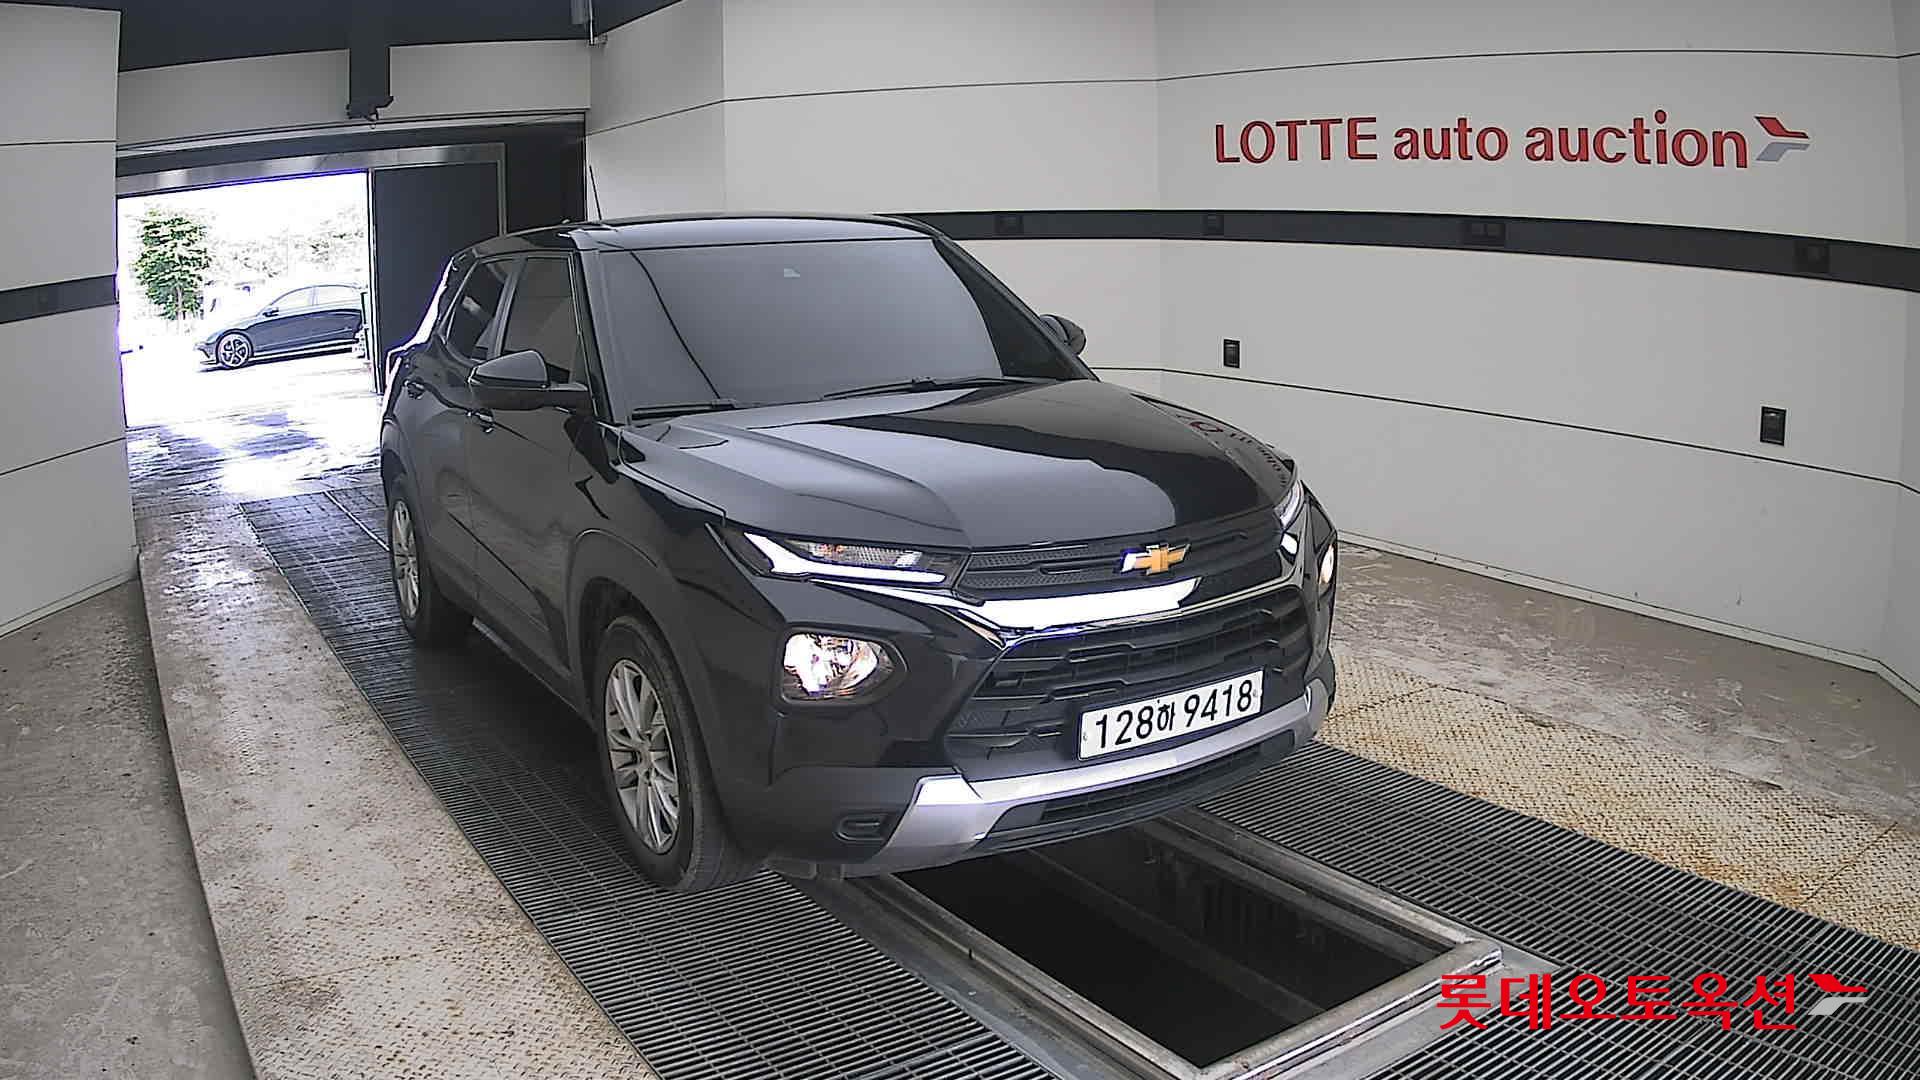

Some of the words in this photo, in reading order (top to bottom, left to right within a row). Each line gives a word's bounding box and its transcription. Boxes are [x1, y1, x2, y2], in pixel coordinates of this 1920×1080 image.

[1215, 116, 1377, 164] LOTTE
[1392, 117, 1509, 162] auto
[1524, 109, 1749, 169] auction
[1096, 702, 1175, 748] 128하
[1184, 680, 1253, 727] 9418
